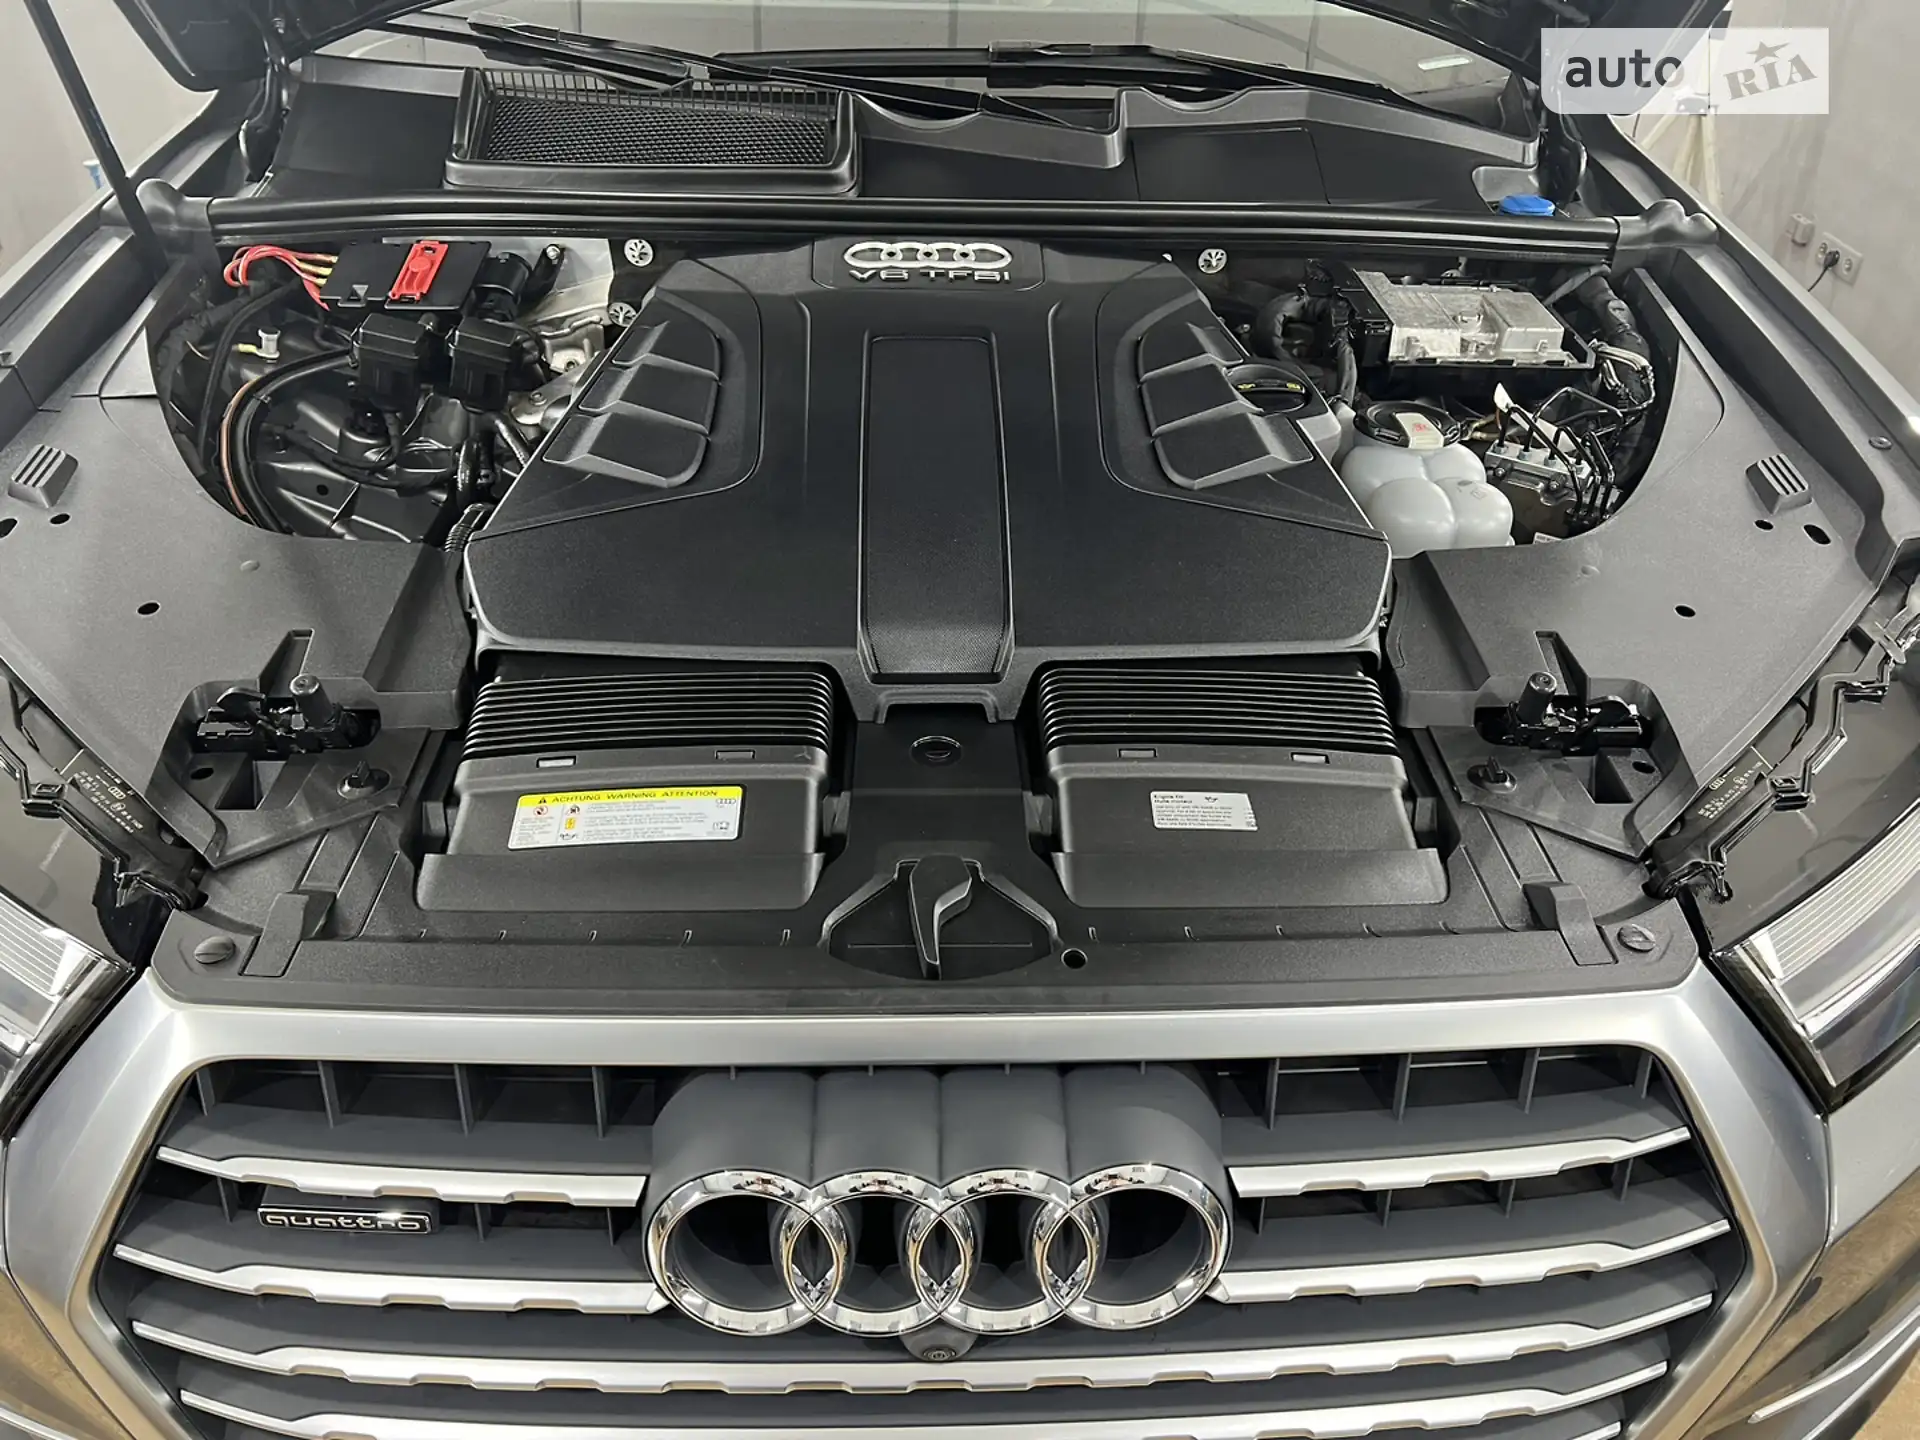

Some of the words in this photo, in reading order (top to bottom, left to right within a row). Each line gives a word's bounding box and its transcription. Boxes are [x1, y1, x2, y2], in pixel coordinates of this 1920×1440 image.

[849, 269, 909, 281] V6
[919, 269, 1010, 282] TFSI
[551, 793, 601, 804] ACHTUNG
[607, 791, 657, 801] WARNING
[662, 790, 719, 798] ATTENTION
[266, 1214, 420, 1231] quattro
